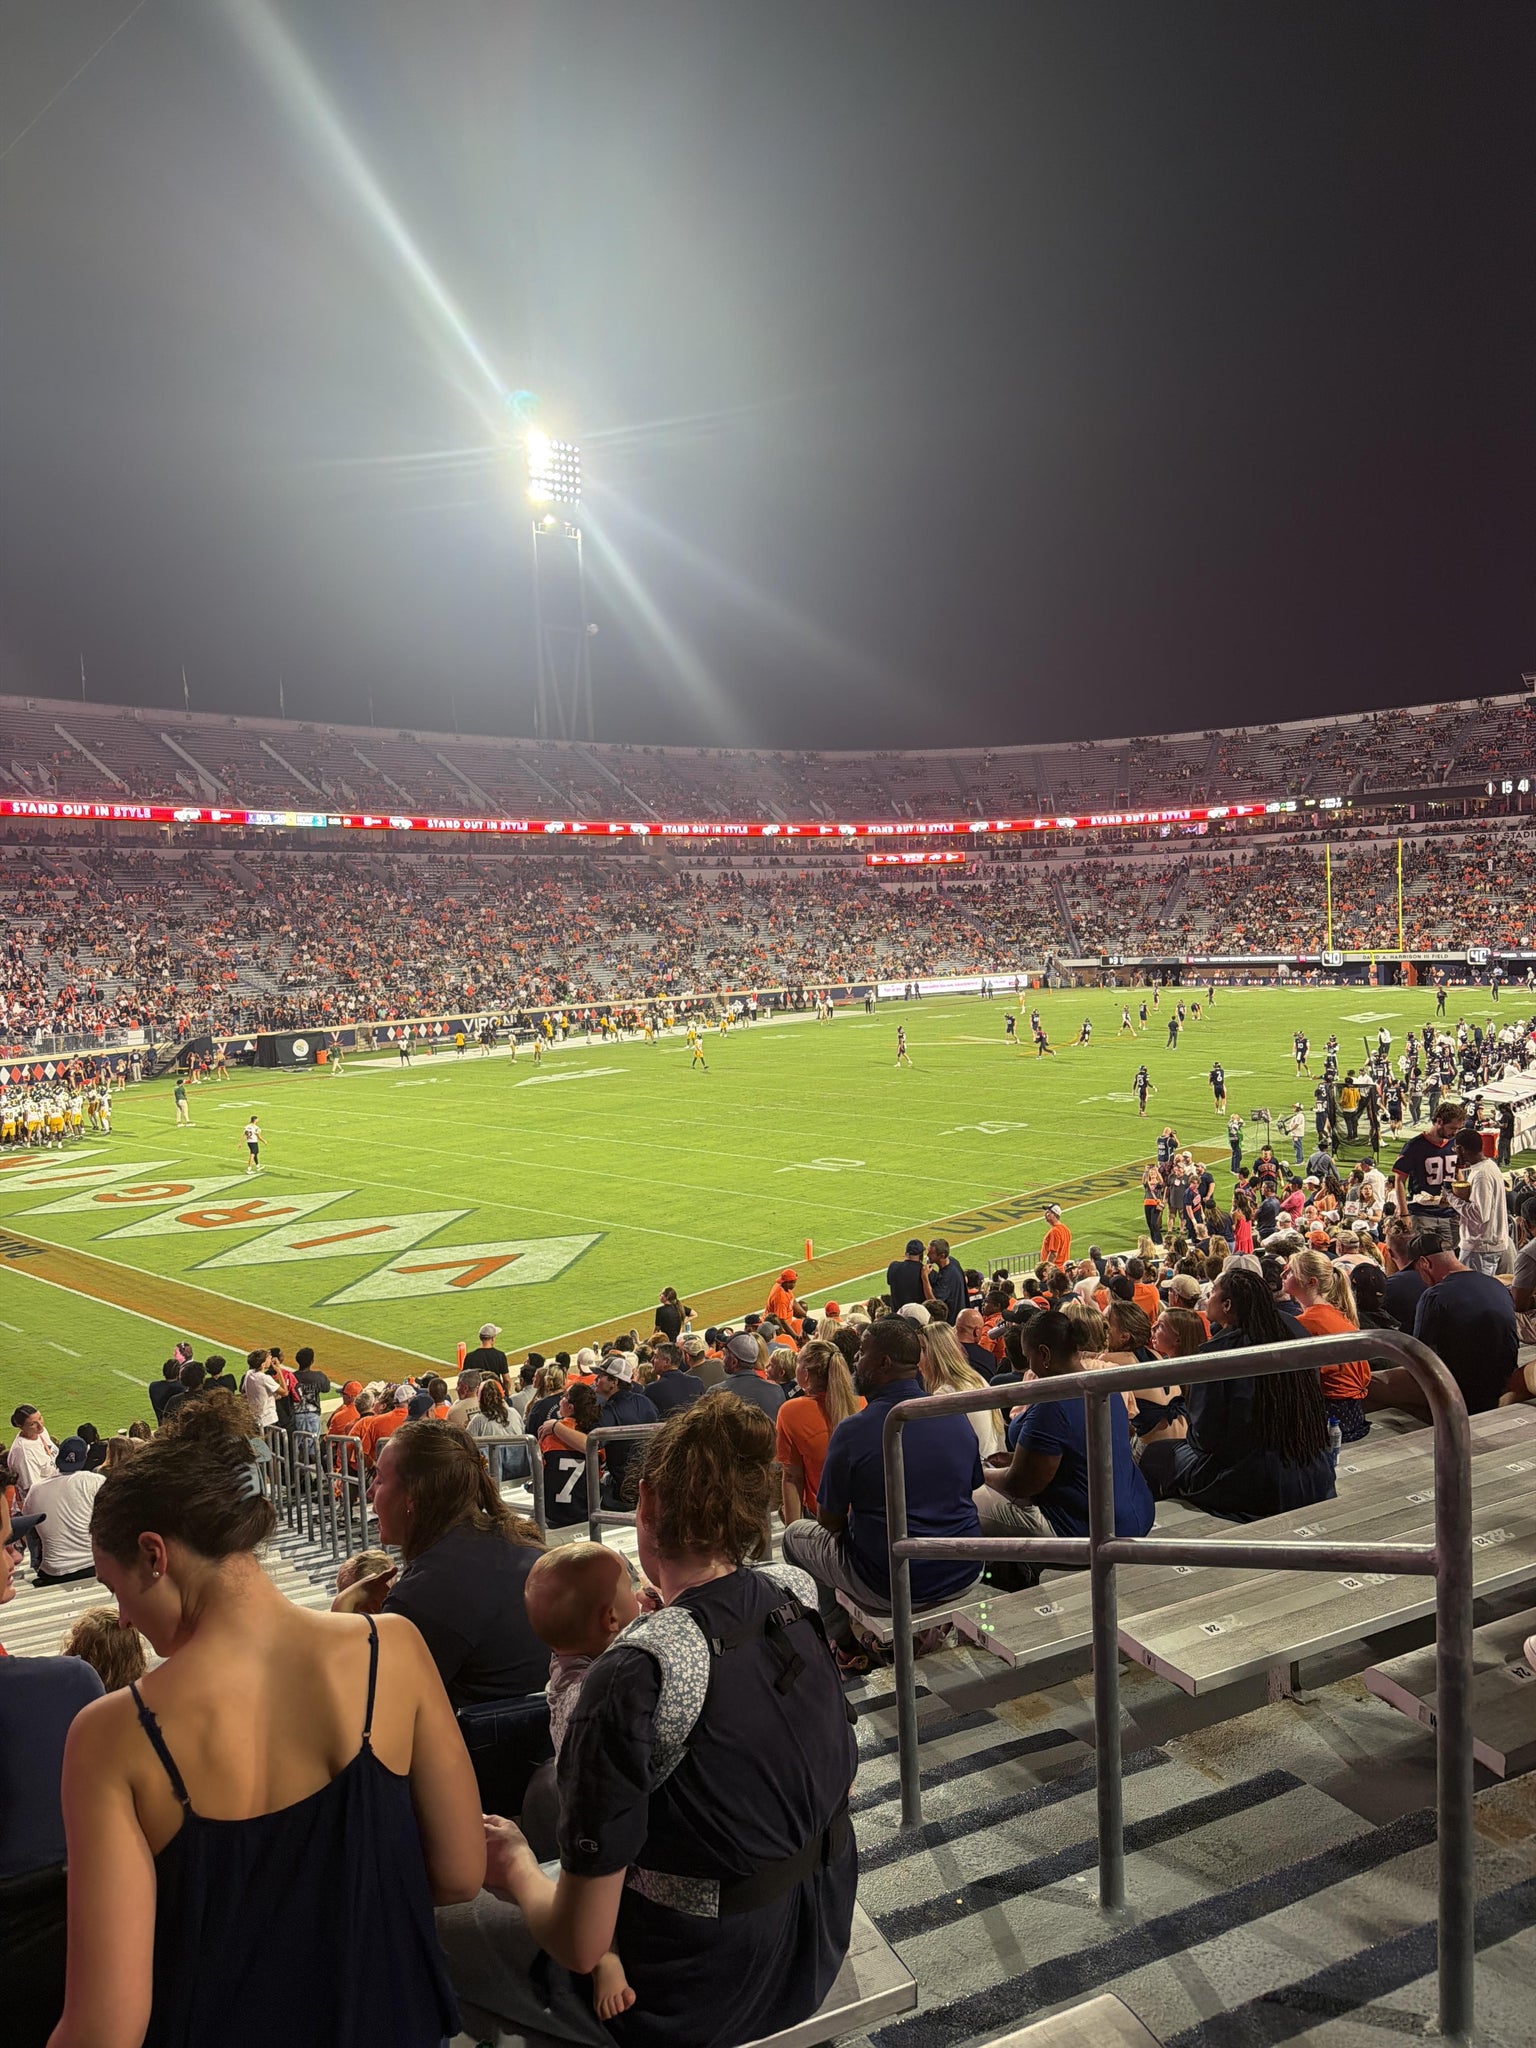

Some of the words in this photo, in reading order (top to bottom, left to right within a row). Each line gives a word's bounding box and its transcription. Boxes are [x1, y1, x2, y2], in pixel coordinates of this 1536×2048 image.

[1502, 781, 1513, 794] 15
[1517, 779, 1529, 792] 41
[12, 802, 58, 815] STAND
[62, 804, 90, 815] OUT
[95, 805, 110, 817] IN
[113, 806, 152, 819] STYLE
[1090, 815, 1122, 825] STAND
[1125, 813, 1145, 823] OUT
[1149, 812, 1159, 822] IN
[1162, 809, 1191, 821] STYLE
[427, 819, 460, 830] STAND
[463, 820, 484, 830] OUT
[486, 821, 498, 831] IN
[500, 821, 529, 831] STYLE
[662, 825, 690, 834] STAND
[692, 825, 710, 834] OUT
[712, 826, 722, 834] IN
[724, 826, 748, 834] STYLE
[868, 824, 894, 833] STAND
[896, 824, 914, 833] OUT
[915, 824, 927, 832] IN
[928, 823, 954, 832] STYLE
[1503, 830, 1536, 840] STADI
[1323, 952, 1340, 965] 40
[462, 1014, 518, 1034] VIRGINI
[1386, 1092, 1399, 1102] 36
[1424, 1154, 1459, 1186] 95
[555, 1457, 586, 1503] 7
[1205, 1624, 1220, 1634] 24
[1511, 1666, 1532, 1679] 24
